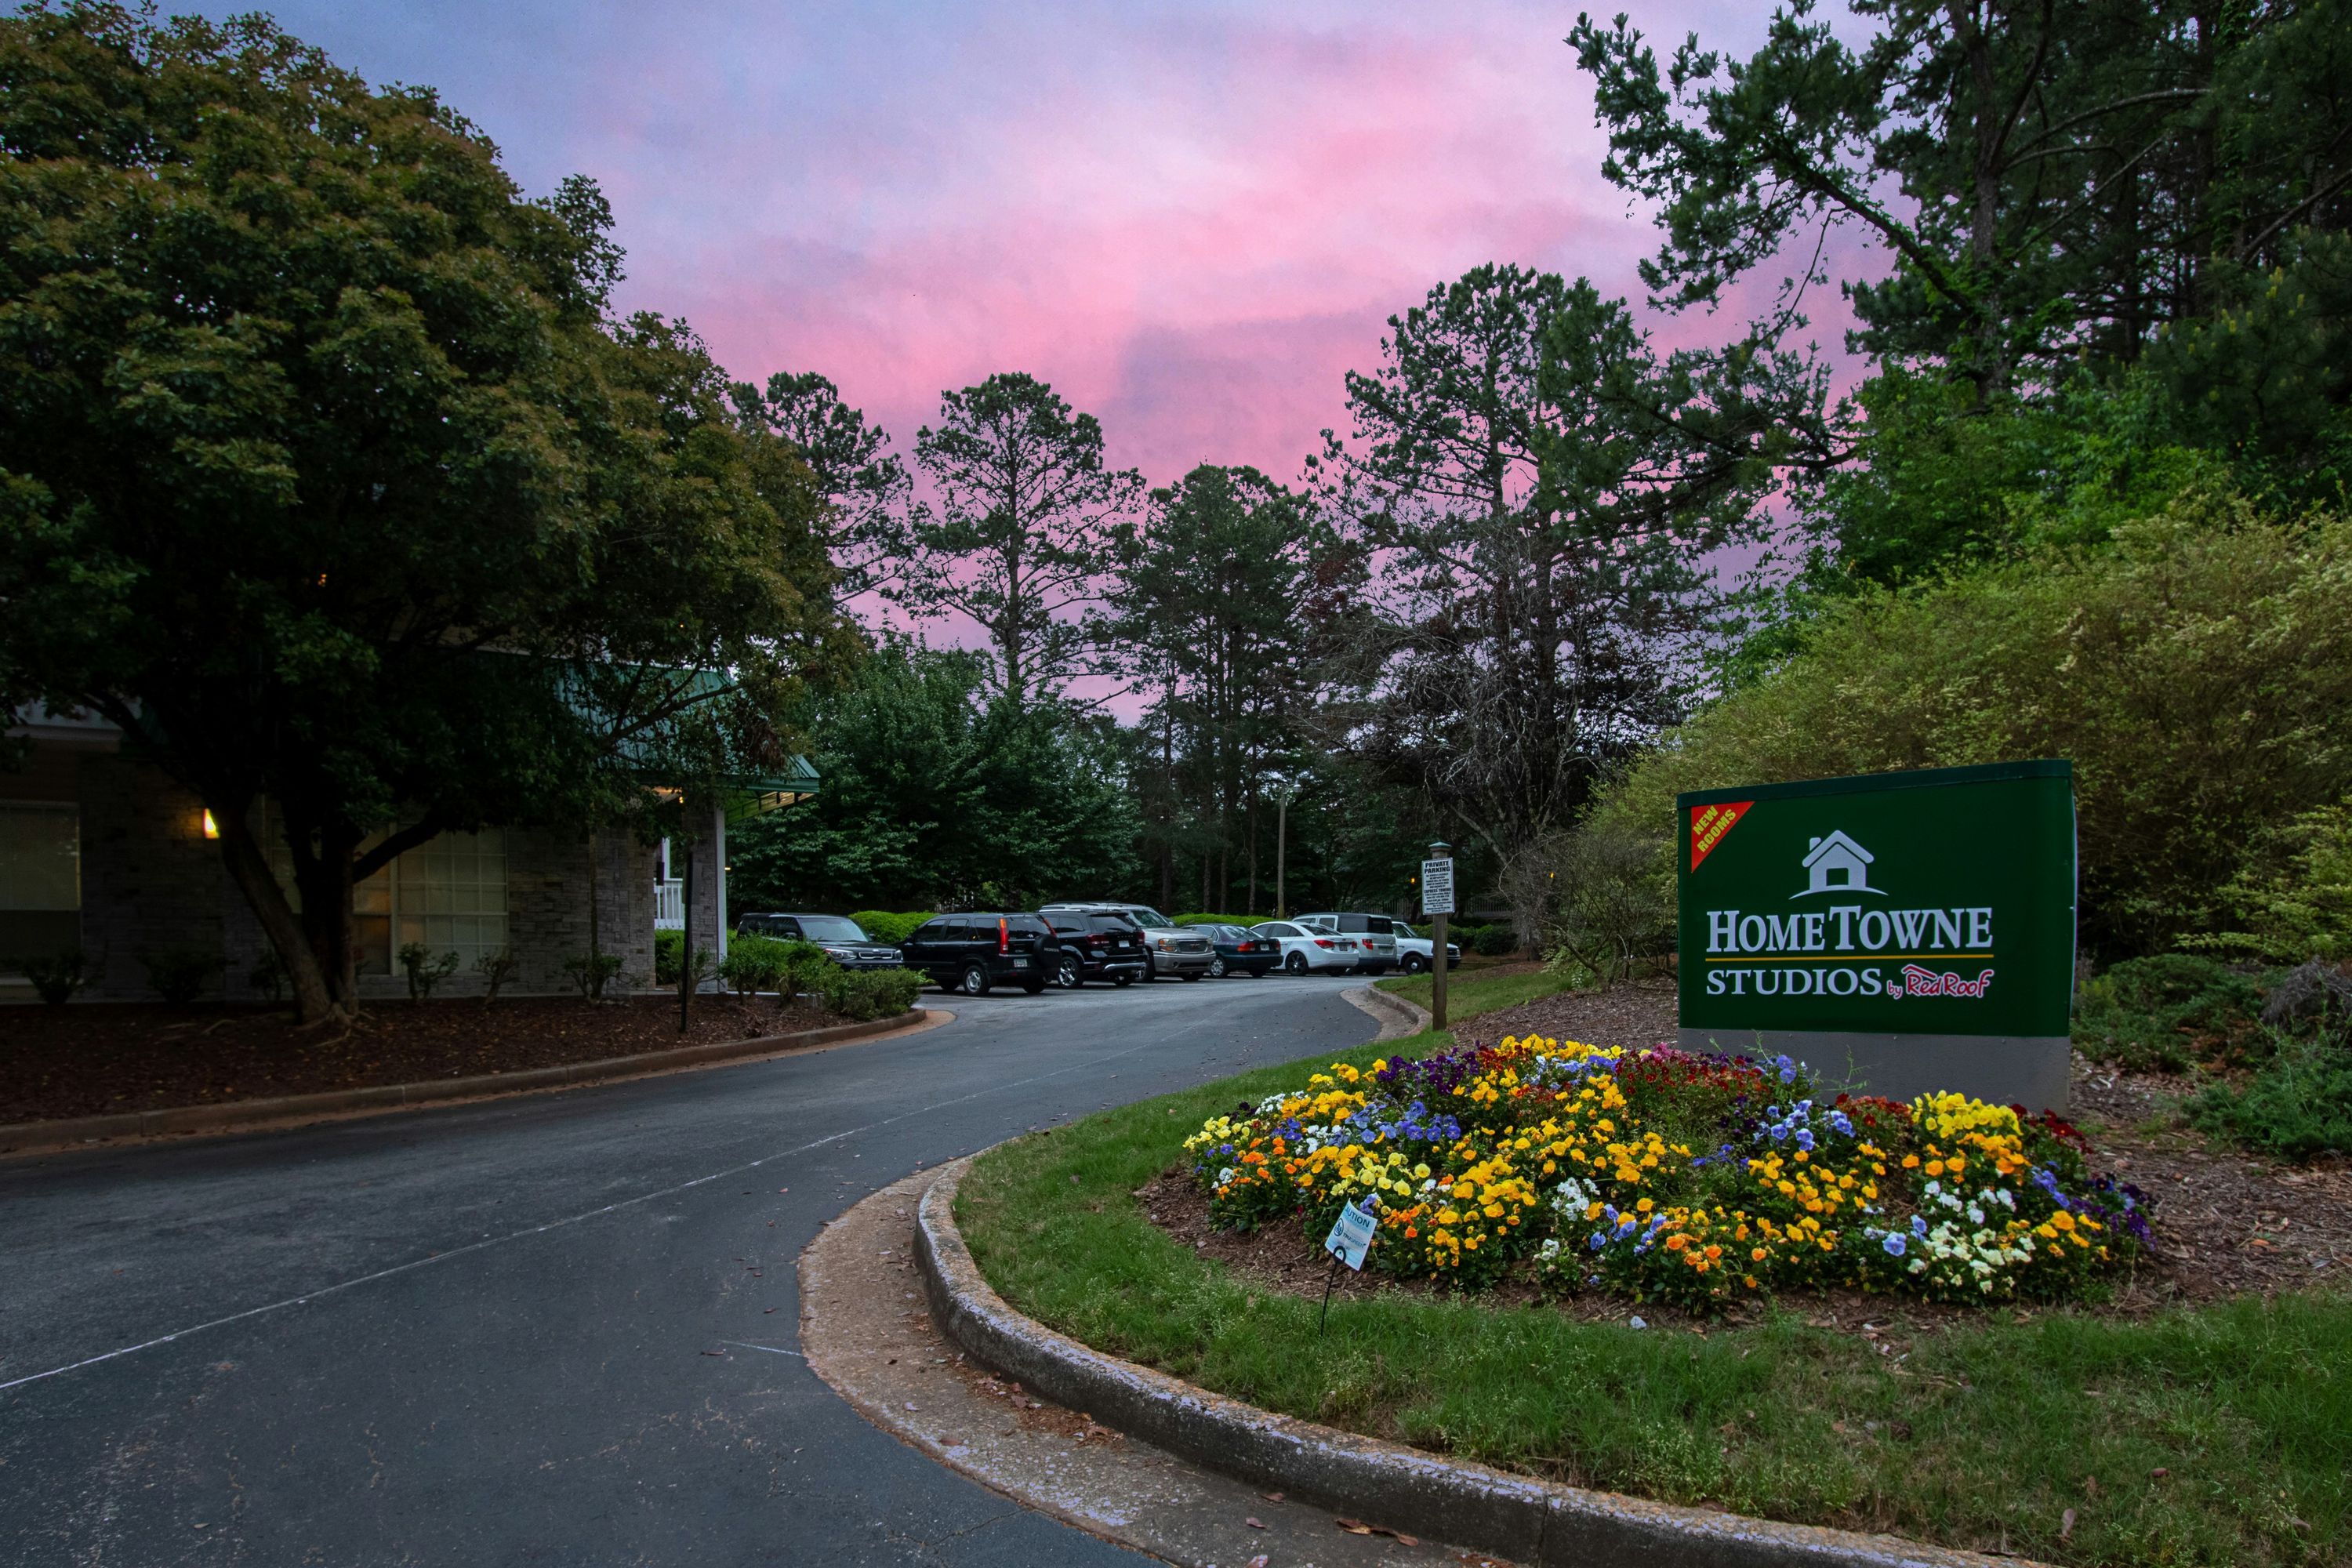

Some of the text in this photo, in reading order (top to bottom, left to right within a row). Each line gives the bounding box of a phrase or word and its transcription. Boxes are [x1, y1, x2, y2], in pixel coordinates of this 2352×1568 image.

[1693, 805, 1719, 836] NEW
[1697, 808, 1737, 852] ROOMS
[1706, 968, 1882, 996] STUDIOS
[1887, 980, 1904, 1000] by
[1344, 1206, 1370, 1229] AUTION
